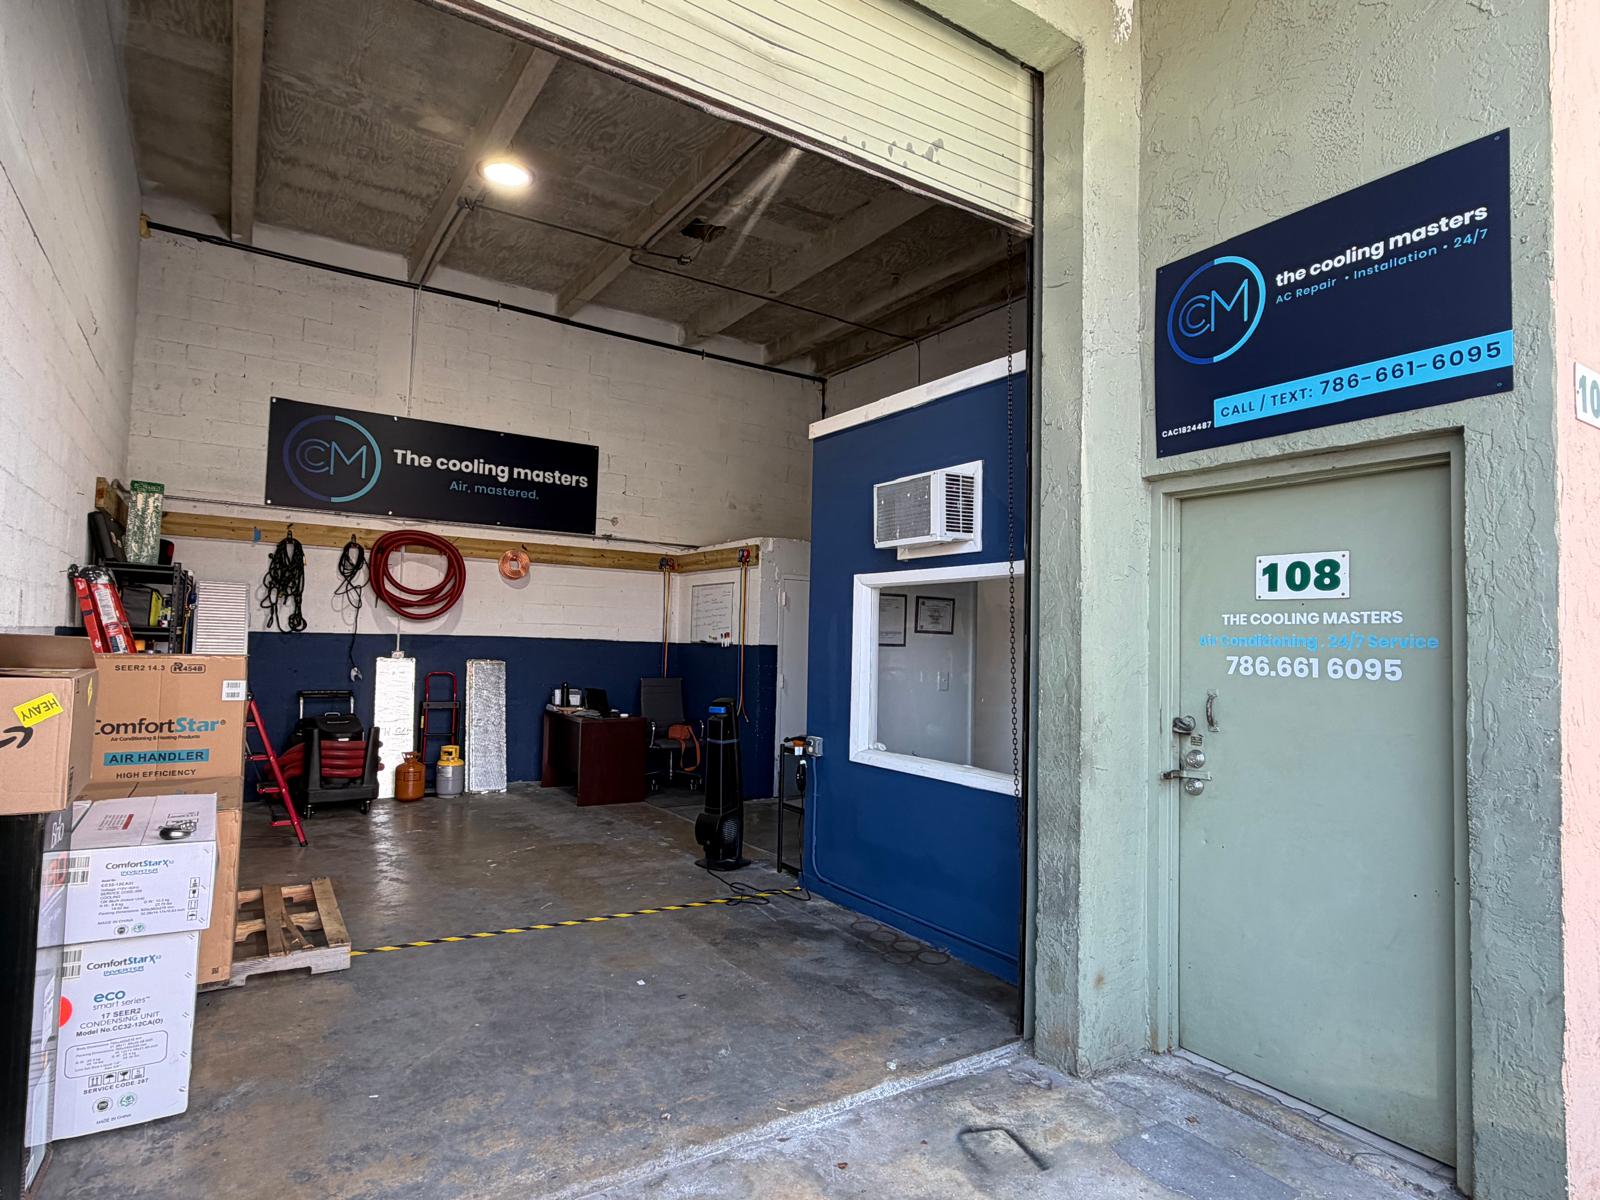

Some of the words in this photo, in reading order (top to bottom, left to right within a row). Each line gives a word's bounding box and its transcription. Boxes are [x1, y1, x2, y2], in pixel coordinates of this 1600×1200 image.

[1275, 268, 1306, 287] the
[1310, 239, 1385, 275] cooling
[1389, 206, 1488, 250] masters
[1276, 291, 1292, 304] AC
[1296, 277, 1337, 298] Repair
[1354, 246, 1437, 279] Installation
[1453, 228, 1488, 249] 24/7
[1220, 401, 1255, 417] CALL
[1270, 387, 1313, 406] TEXT:
[1320, 341, 1502, 396] 786-661-6095
[393, 449, 432, 468] The
[436, 457, 509, 483] cooling
[513, 466, 589, 488] masters
[474, 484, 539, 500] mastered.
[1262, 558, 1341, 592] 108
[1222, 613, 1248, 625] THE
[1250, 612, 1320, 625] COOLING
[1322, 610, 1404, 625] MASTERS
[1219, 633, 1319, 652] Conditioning
[1327, 632, 1365, 650] 24/7
[1367, 634, 1440, 650] Service
[114, 664, 146, 672] SEER2
[148, 664, 166, 672] 14.3
[1225, 655, 1319, 678] 786.661
[1326, 657, 1403, 681] 6095
[20, 698, 59, 722] HEAVY
[108, 753, 134, 764] AIR
[138, 751, 205, 762] HANDLER
[116, 772, 140, 780] HIGH
[142, 769, 197, 778] EFFICIENCY
[93, 990, 126, 1003] eco
[92, 1001, 119, 1011] smart
[113, 1007, 142, 1018] SEER2
[80, 1016, 138, 1030] CONDENSING
[140, 1011, 160, 1020] UNIT
[75, 1028, 98, 1037] Model
[83, 1084, 114, 1095] SERVICE
